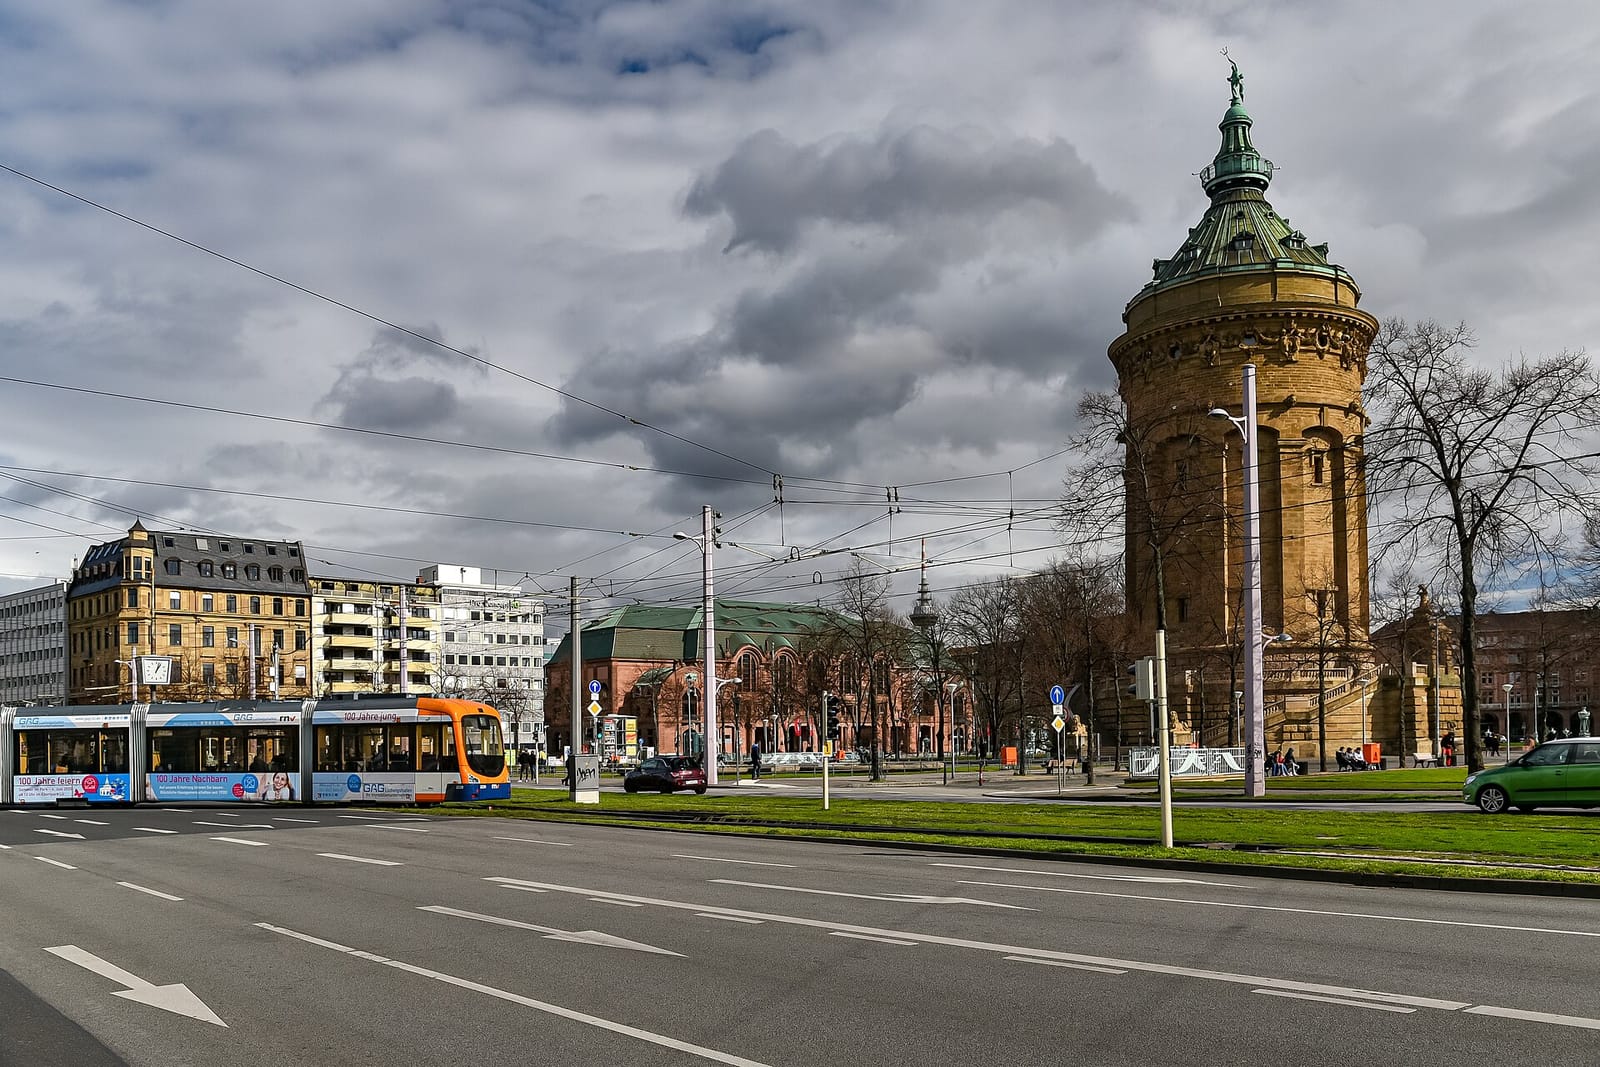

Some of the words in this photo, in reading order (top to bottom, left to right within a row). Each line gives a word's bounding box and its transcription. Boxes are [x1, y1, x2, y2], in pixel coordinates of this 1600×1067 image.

[344, 712, 356, 721] 100
[357, 712, 378, 721] Jahre
[380, 712, 397, 722] jung
[18, 777, 32, 785] 100
[33, 777, 57, 785] Jahre
[57, 776, 81, 785] feiern
[156, 775, 168, 783] 100
[169, 775, 190, 783] Jahre
[192, 775, 228, 783] Nachbarn
[363, 783, 384, 792] GAG
